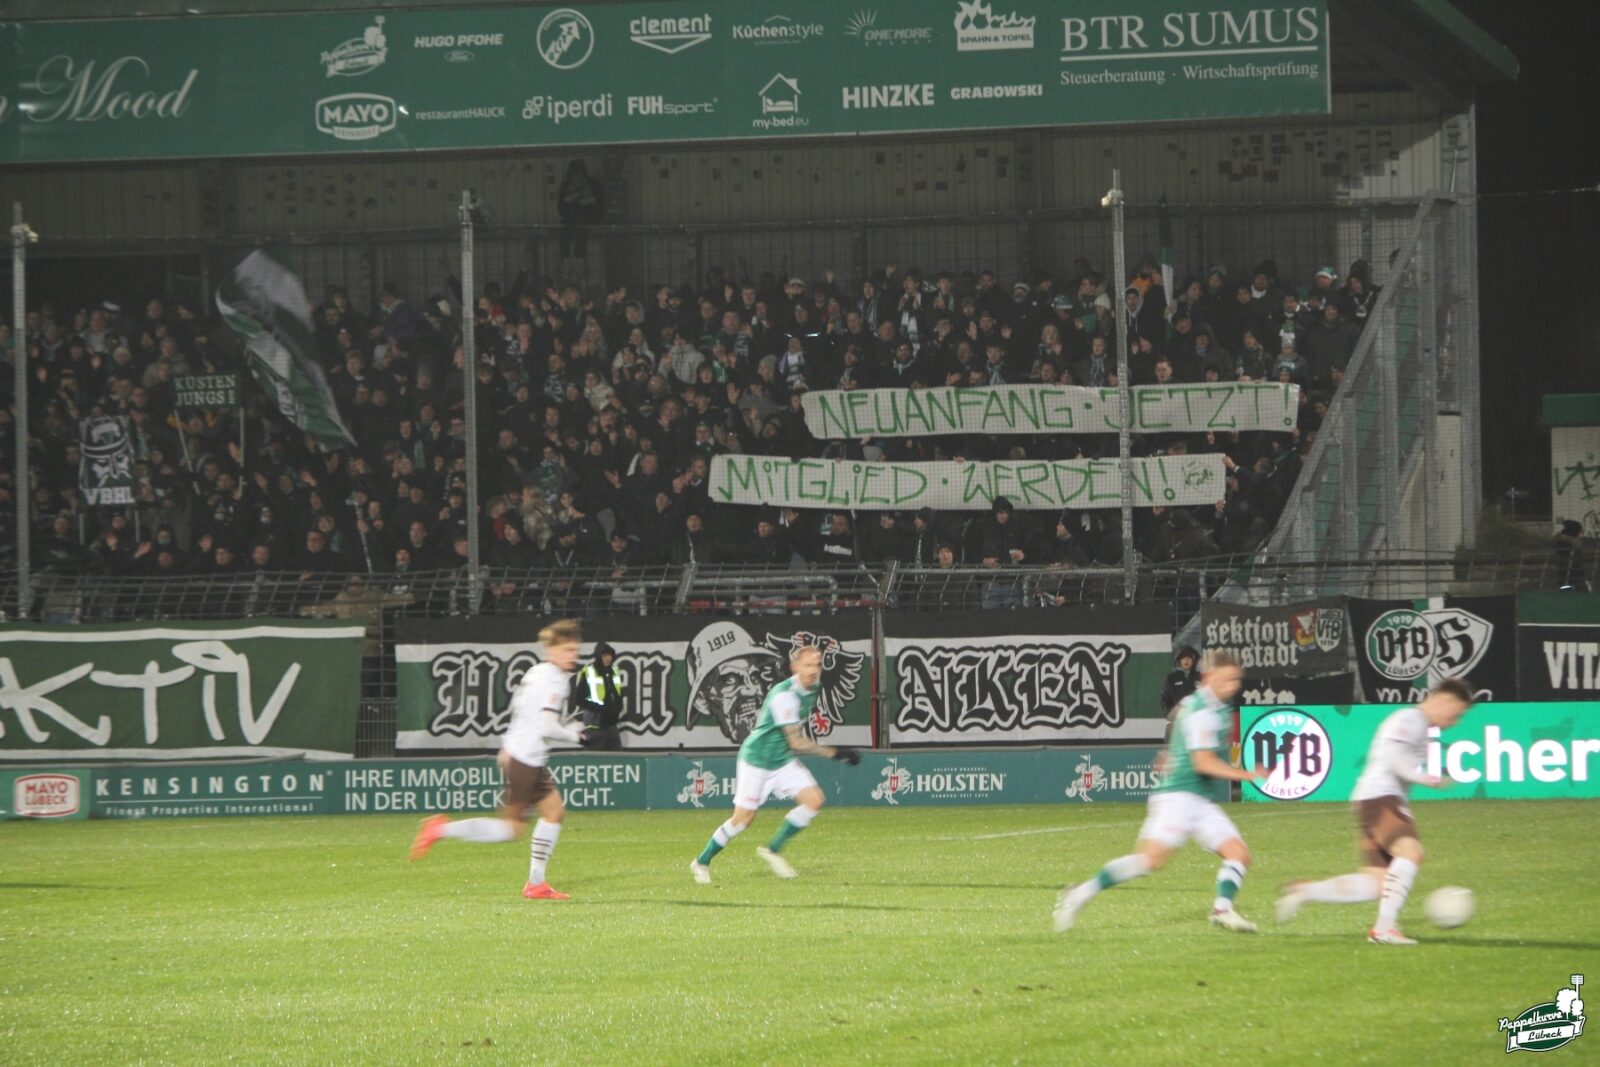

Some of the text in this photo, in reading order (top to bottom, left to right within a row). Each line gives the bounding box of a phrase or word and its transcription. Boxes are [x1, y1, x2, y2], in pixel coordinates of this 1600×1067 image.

[629, 13, 712, 35] clement
[1061, 6, 1319, 52] BTR SUMUS
[414, 32, 504, 48] HUGO PFOHE
[1060, 60, 1319, 86] Steuerberatung Wirtschaftsprüfung
[28, 54, 199, 123] Mood
[842, 83, 935, 110] HINZKE
[950, 84, 1043, 101] GRABOWSKI
[323, 103, 389, 124] MAYO
[547, 93, 613, 124] iperdi
[175, 390, 225, 407] JUNGS
[818, 388, 1073, 439] NEUANFANG
[1387, 615, 1414, 627] 1919
[706, 631, 737, 653] 1919
[1387, 663, 1422, 677] LÜBECK
[1268, 714, 1303, 728] 1919
[1416, 725, 1600, 784] icher
[25, 780, 68, 795] MAYO
[96, 774, 325, 797] KENSINGTON
[345, 769, 395, 789] IHRE
[916, 773, 1003, 793] HOLSTEN
[345, 793, 367, 811] IN
[374, 792, 417, 811] DER
[424, 787, 508, 811] LÜBECK
[1264, 783, 1309, 797] LÜBECK
[106, 802, 314, 817] Finest Properties International
